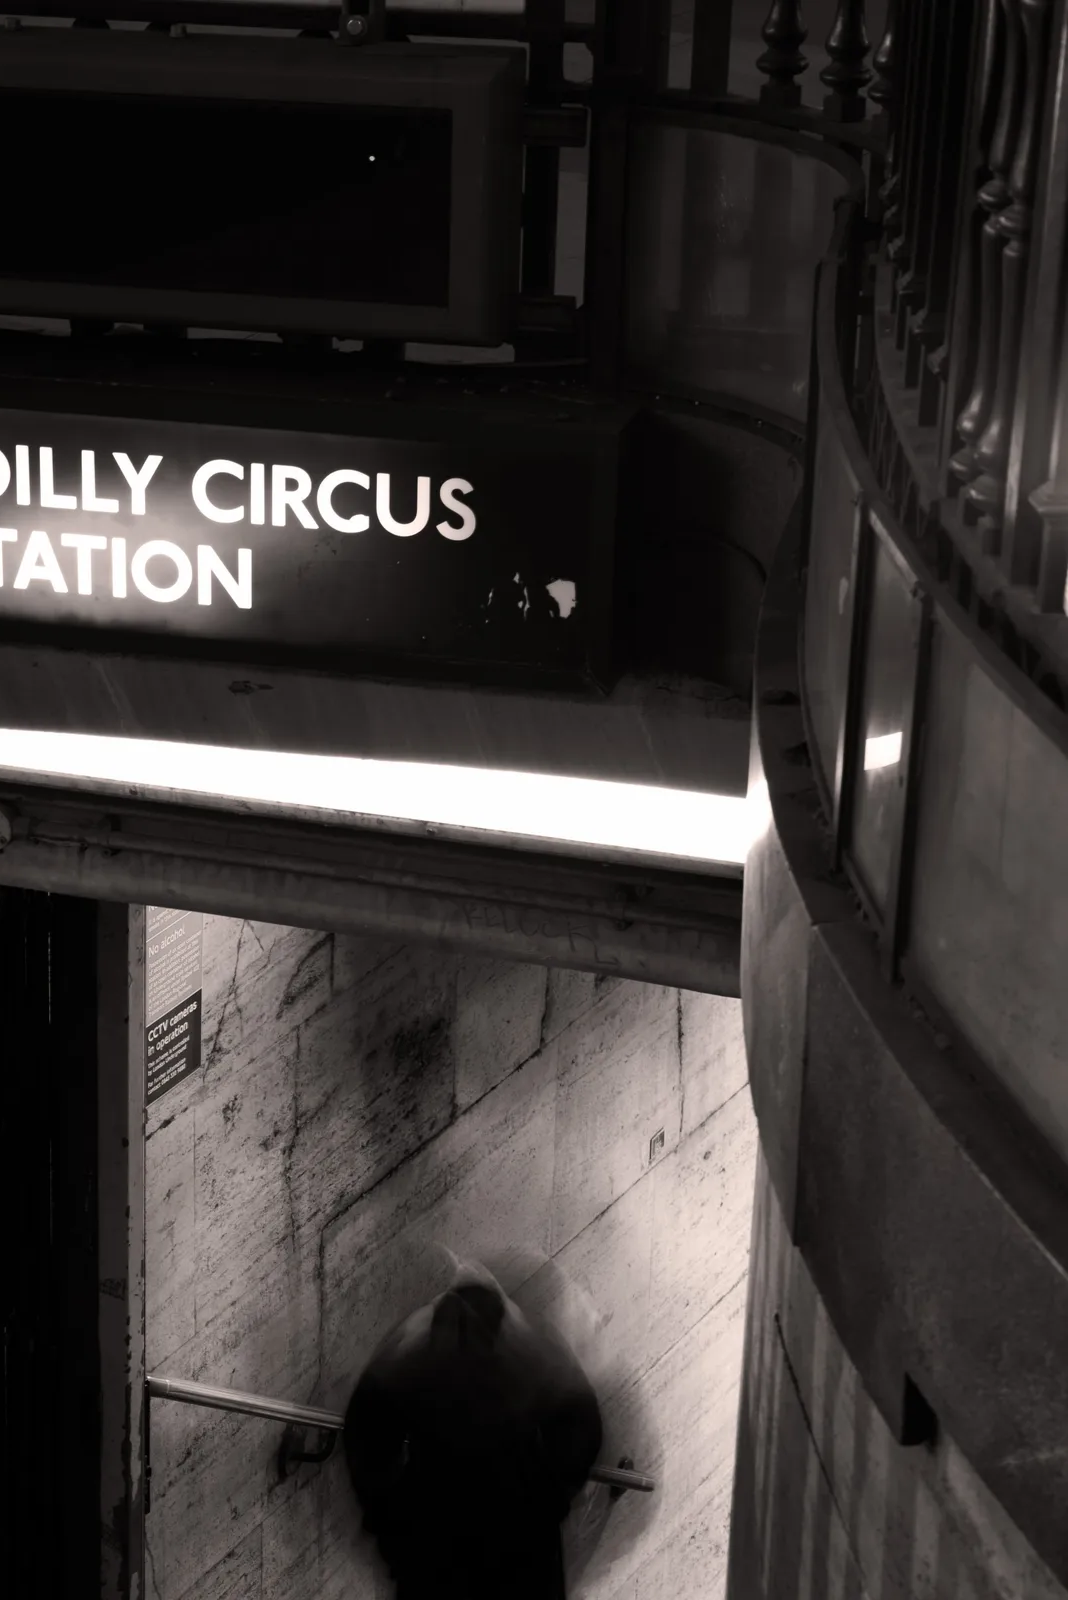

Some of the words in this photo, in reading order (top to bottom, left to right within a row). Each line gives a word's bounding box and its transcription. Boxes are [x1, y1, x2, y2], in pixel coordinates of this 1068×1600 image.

[191, 458, 477, 542] CIRCUS
[148, 944, 159, 958] No
[160, 922, 185, 949] alcohol
[148, 1019, 169, 1042] CCTV
[169, 1001, 197, 1026] cameras
[148, 1046, 154, 1056] in
[156, 1022, 188, 1050] operation
